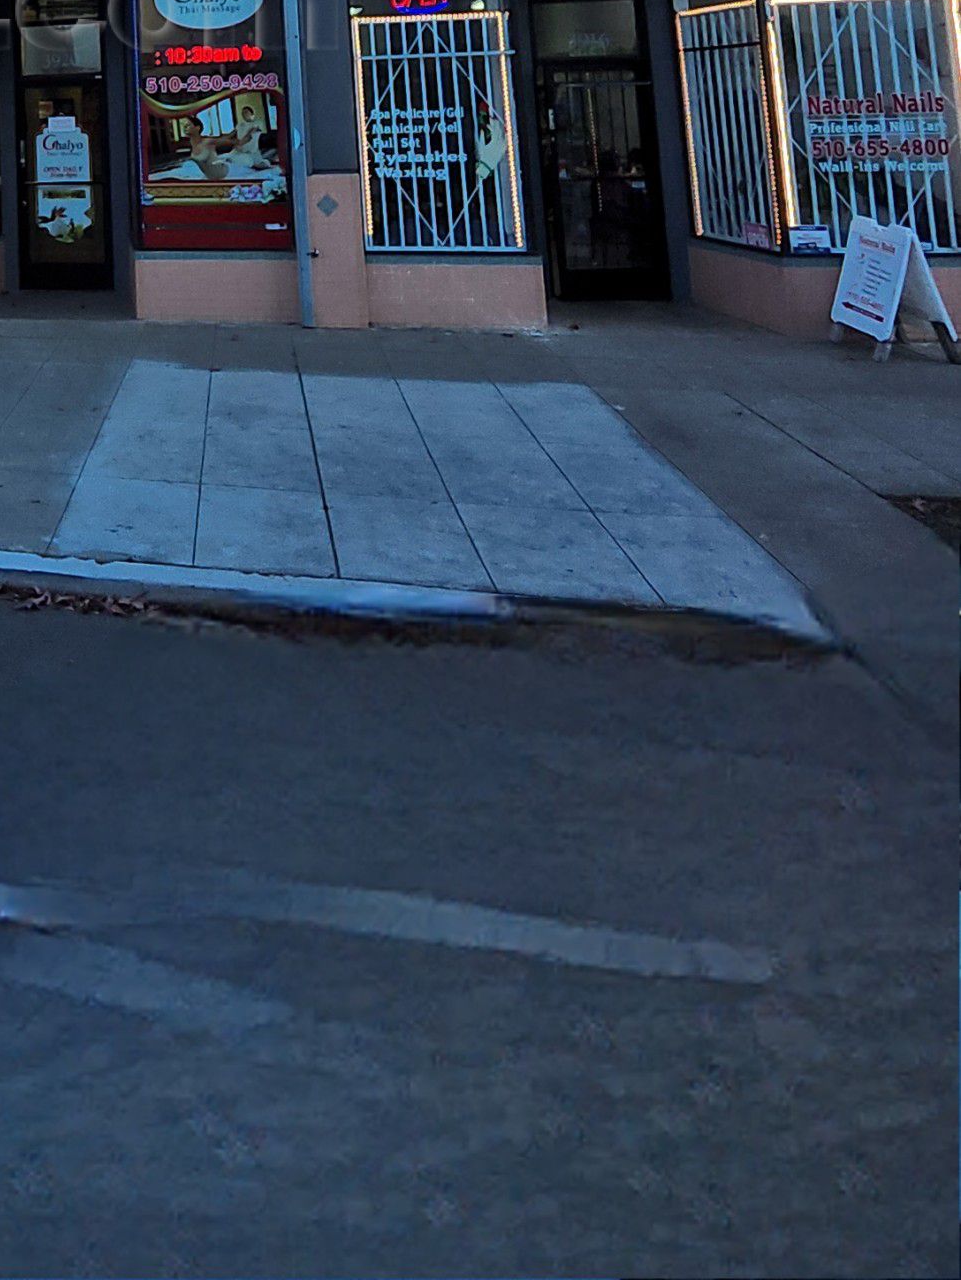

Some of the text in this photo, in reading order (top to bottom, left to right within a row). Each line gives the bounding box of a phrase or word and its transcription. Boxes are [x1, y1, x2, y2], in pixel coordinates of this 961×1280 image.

[145, 72, 279, 94] 510-250-9428
[807, 91, 945, 117] Natural Nails
[811, 138, 951, 158] 510-655-4800
